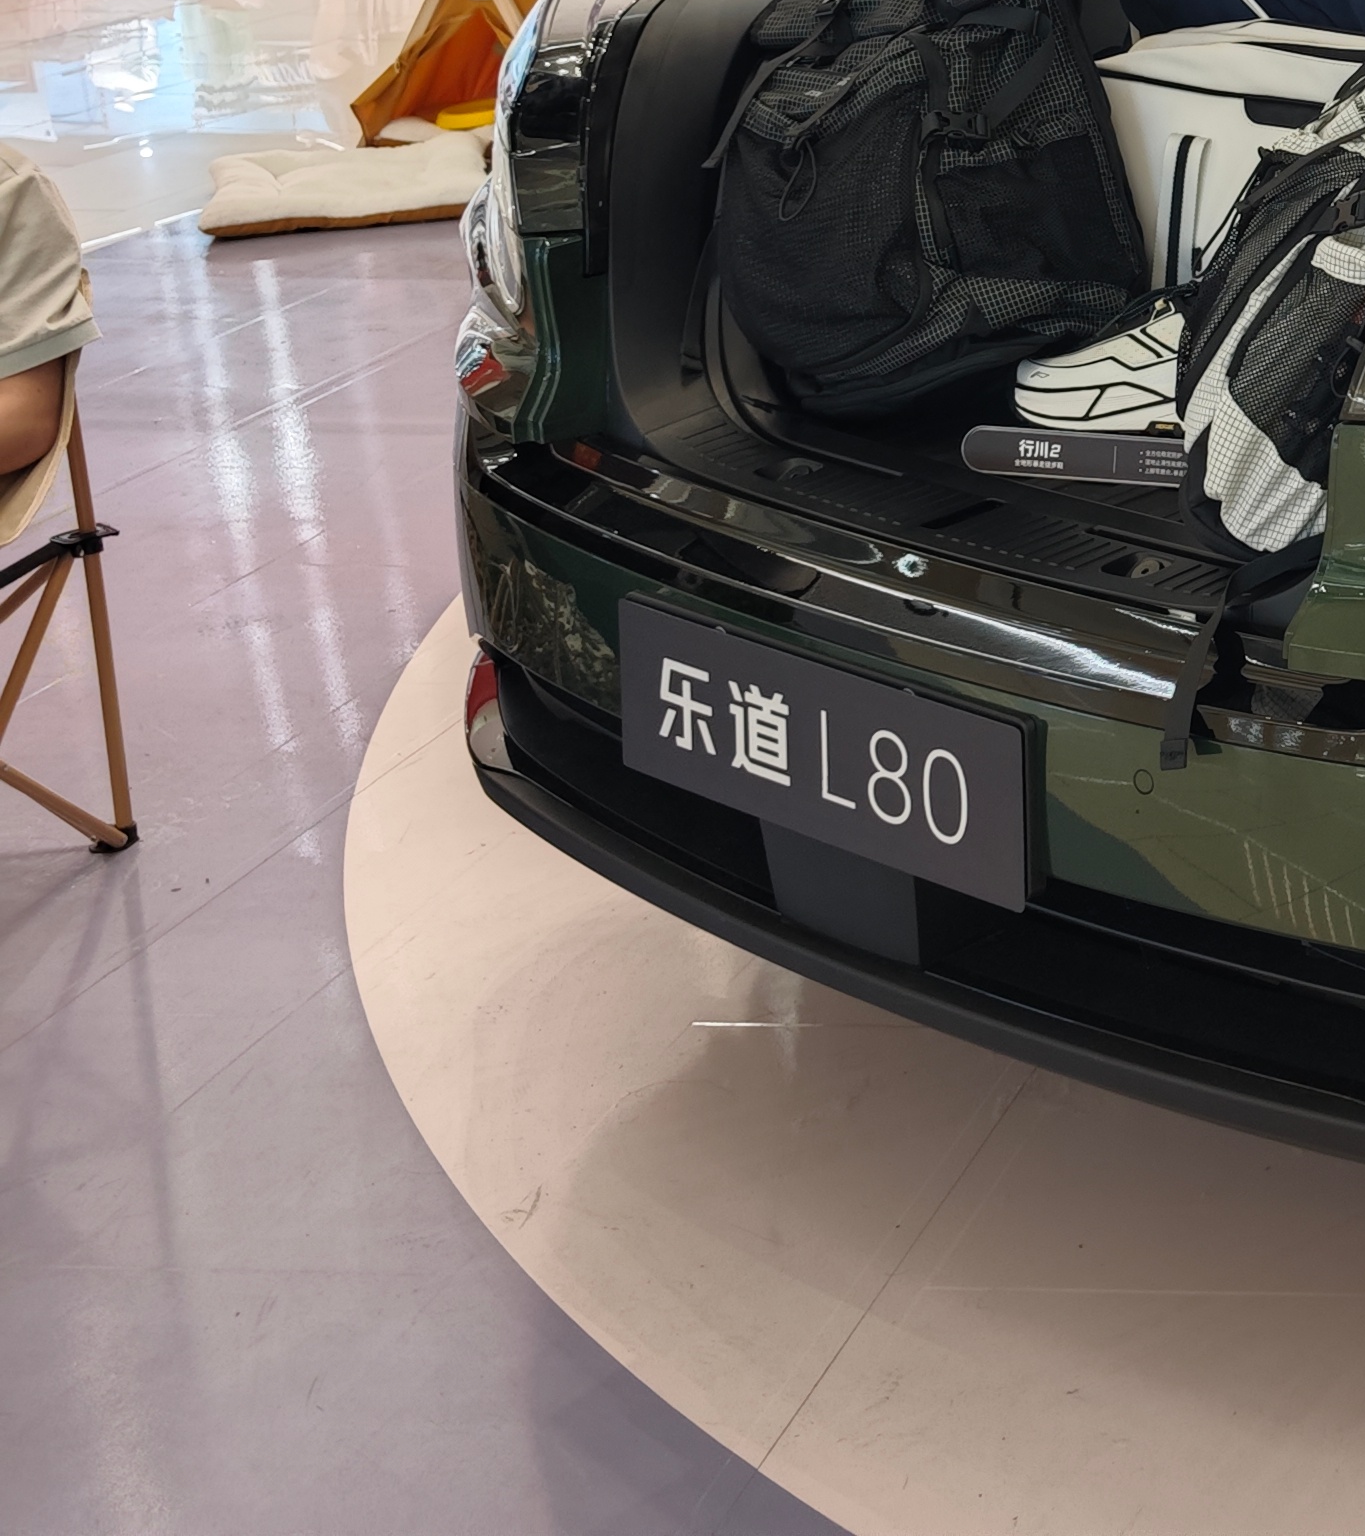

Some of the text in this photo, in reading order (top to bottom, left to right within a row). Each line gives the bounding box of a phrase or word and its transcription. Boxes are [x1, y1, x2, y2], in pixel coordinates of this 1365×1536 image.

[1018, 439, 1062, 459] 行川2
[658, 656, 969, 846] 乐道 L80
